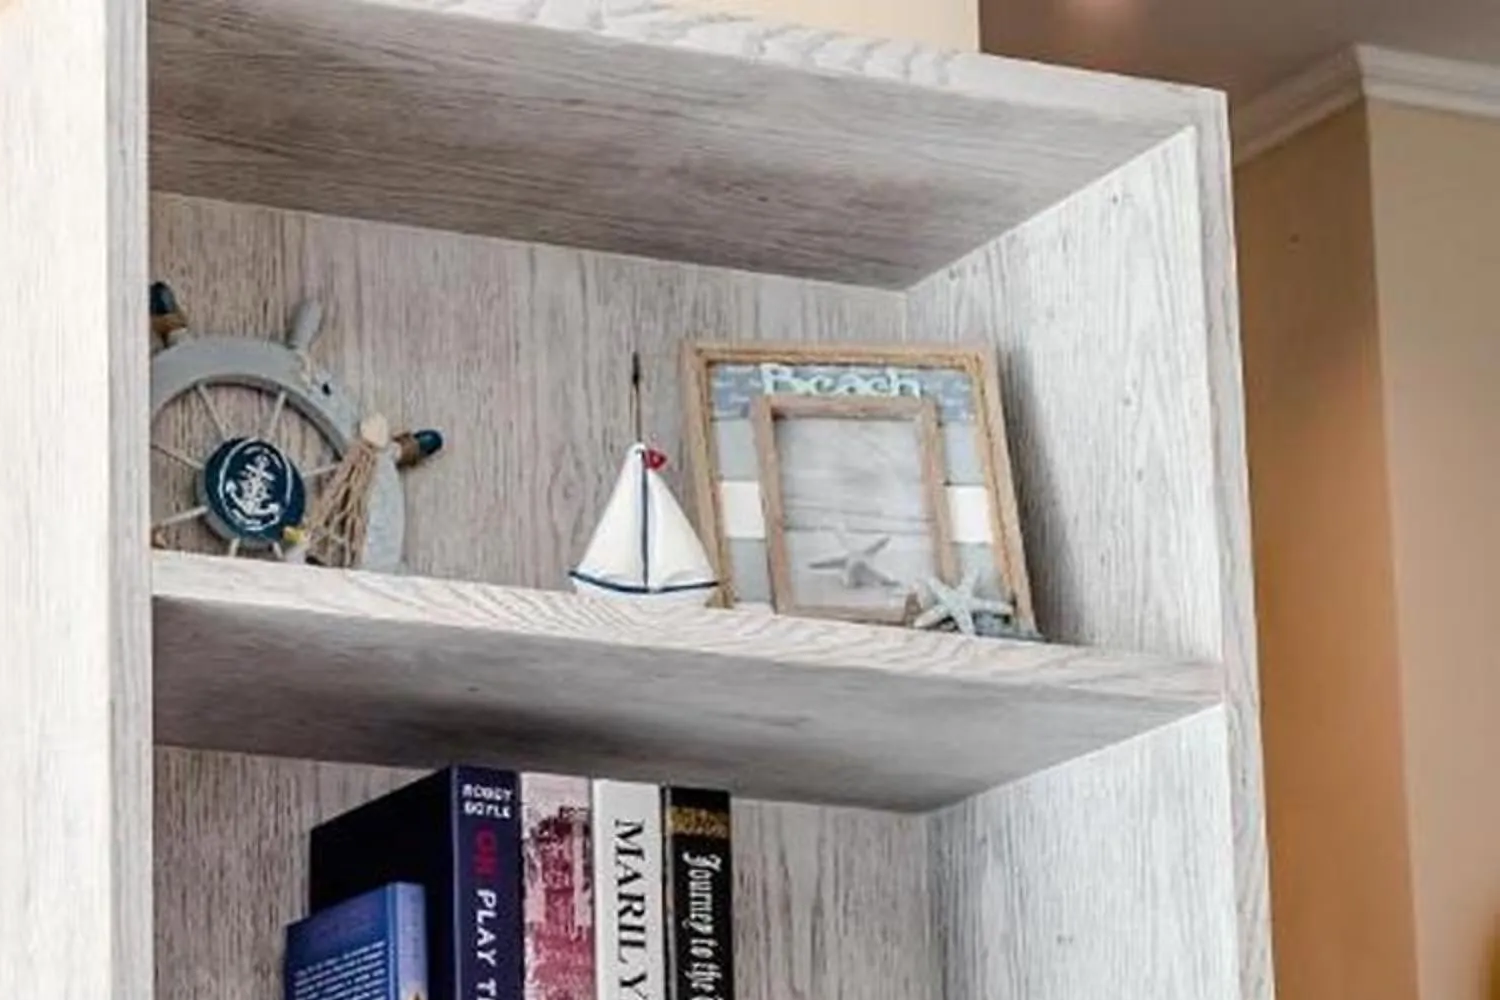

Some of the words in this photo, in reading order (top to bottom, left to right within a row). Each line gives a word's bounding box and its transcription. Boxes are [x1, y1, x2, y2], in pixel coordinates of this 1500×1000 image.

[760, 363, 921, 399] Beach
[681, 852, 722, 934] Journey
[476, 889, 497, 967] PLAY
[690, 937, 719, 959] to
[684, 961, 722, 992] the
